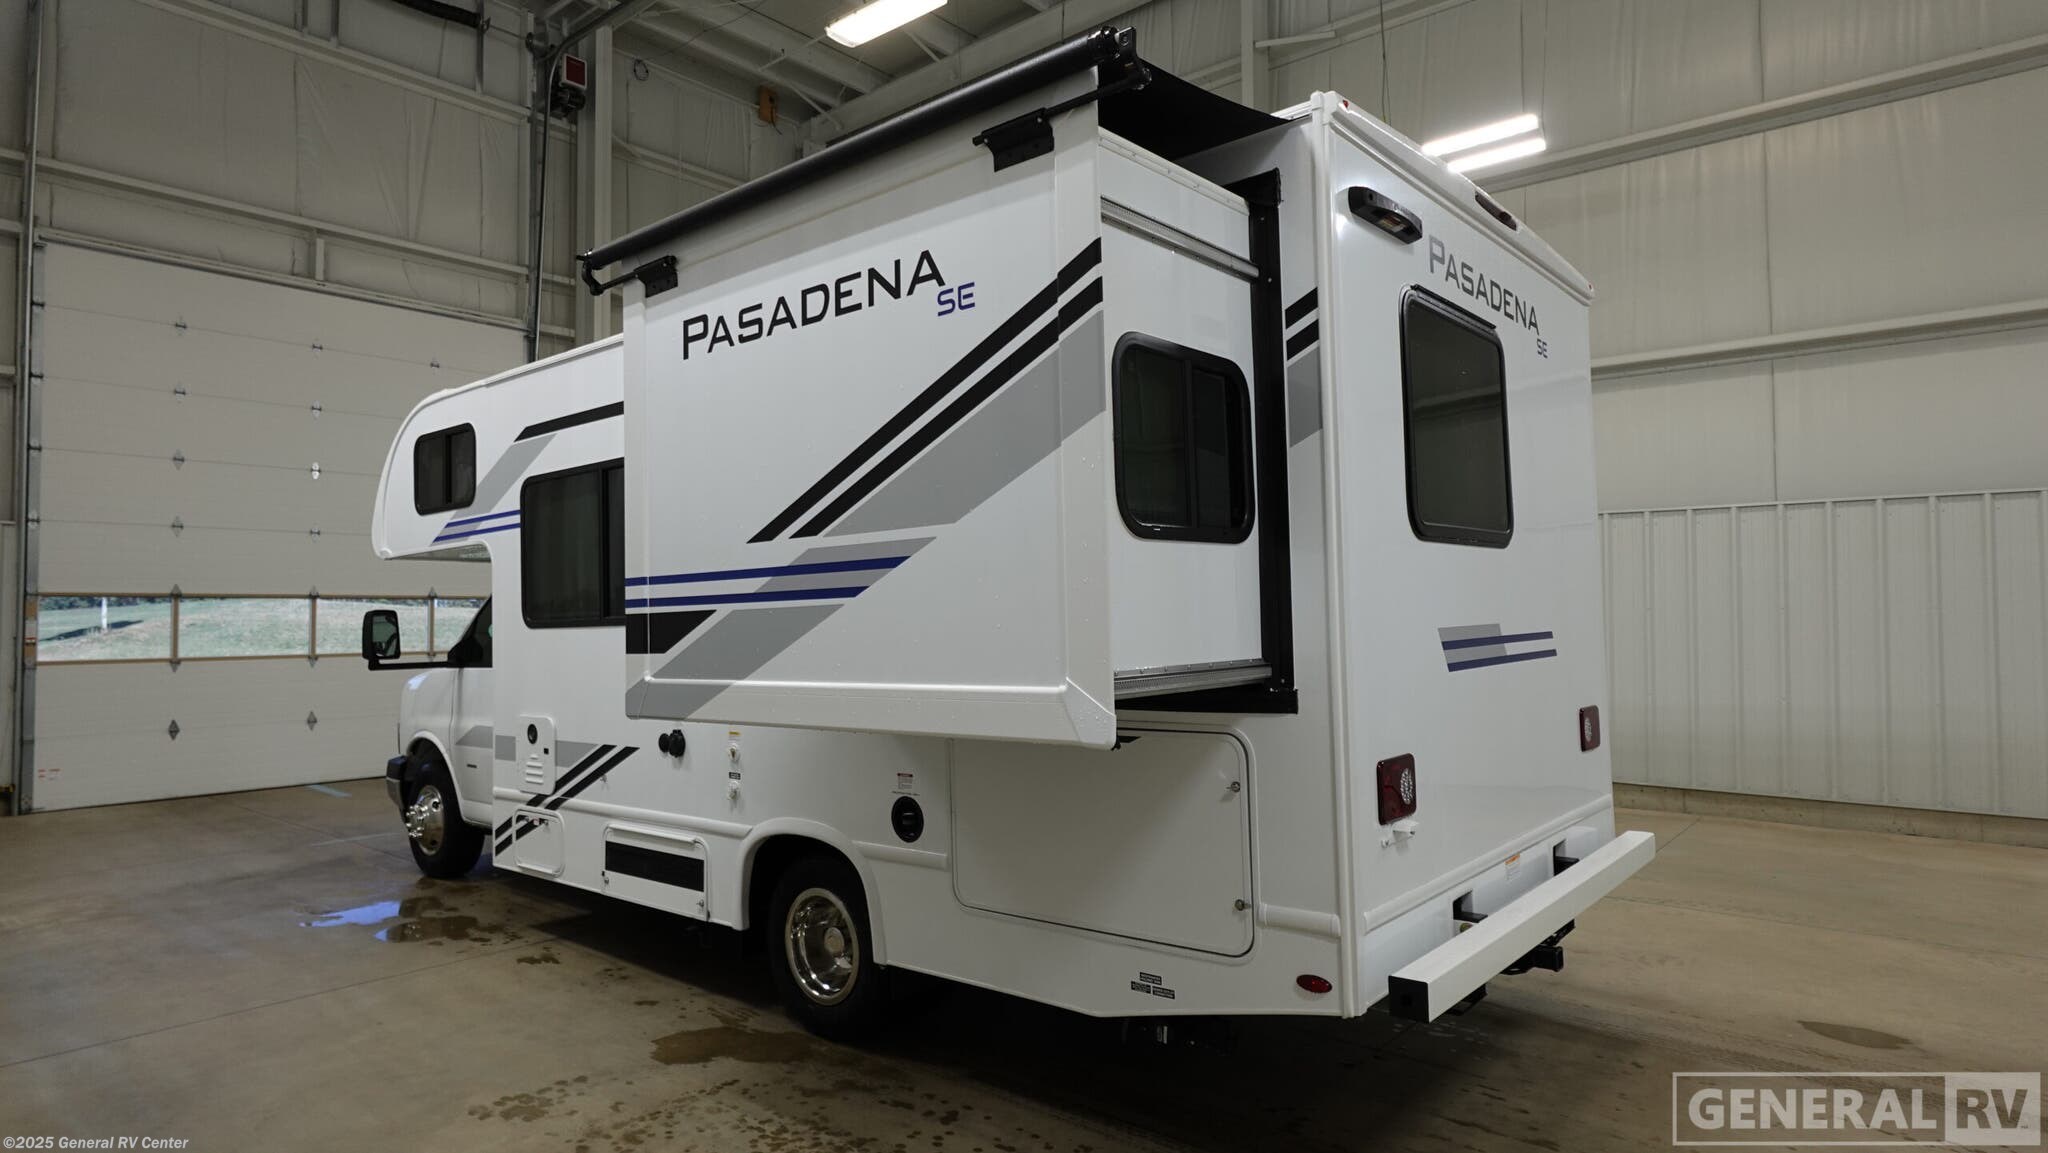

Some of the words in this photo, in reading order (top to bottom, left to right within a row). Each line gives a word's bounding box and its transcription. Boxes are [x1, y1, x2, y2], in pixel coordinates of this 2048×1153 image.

[683, 249, 945, 360] PASADENA
[937, 282, 975, 317] SE
[1428, 234, 1540, 336] PASADENA
[1536, 338, 1549, 359] SE
